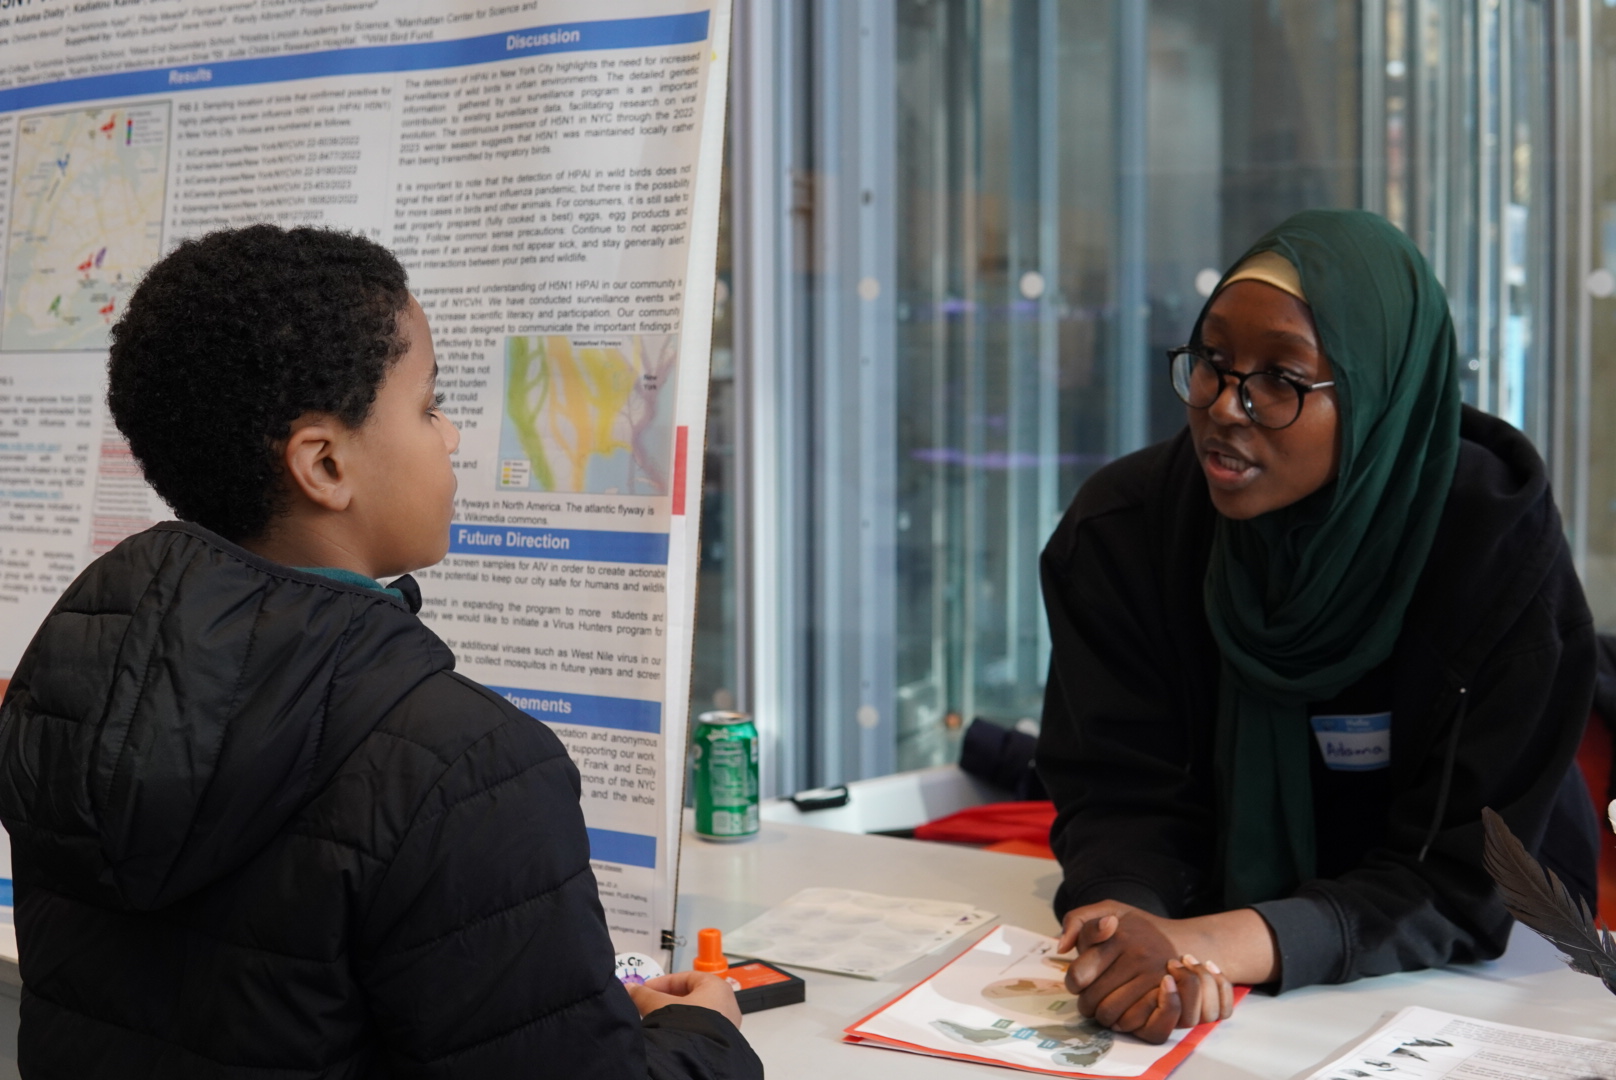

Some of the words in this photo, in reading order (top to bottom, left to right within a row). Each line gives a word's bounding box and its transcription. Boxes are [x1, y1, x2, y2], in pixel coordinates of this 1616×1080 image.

[506, 28, 580, 50] Discussion
[169, 68, 212, 84] Results
[422, 286, 463, 294] awareness
[465, 284, 480, 294] and
[482, 282, 536, 293] understanding
[538, 281, 546, 290] of
[548, 280, 572, 290] H5N1
[575, 279, 598, 289] HPAI
[612, 281, 626, 289] our
[630, 279, 675, 289] community
[440, 298, 448, 307] of
[452, 297, 483, 306] NYCVH.
[488, 297, 501, 305] We
[506, 297, 524, 305] have
[528, 295, 572, 304] conducted
[576, 294, 629, 303] surveillance
[634, 293, 664, 302] events
[470, 310, 502, 320] scientific
[506, 310, 534, 319] literacy
[537, 309, 553, 318] and
[556, 308, 611, 318] participation.
[617, 307, 633, 317] Our
[451, 325, 466, 334] also
[470, 324, 504, 335] designed
[507, 324, 514, 332] to
[518, 323, 572, 331] communicate
[576, 322, 589, 331] the
[593, 322, 635, 332] important
[639, 321, 671, 333] findings
[436, 338, 472, 349] effectively
[474, 338, 482, 347] to
[483, 338, 496, 346] the
[447, 351, 468, 360] While
[470, 351, 484, 360] this
[460, 365, 475, 374] has
[477, 365, 490, 374] not
[458, 378, 486, 387] burden
[456, 392, 478, 401] could
[460, 406, 483, 414] threat
[461, 498, 490, 509] flyways
[501, 500, 524, 509] North
[526, 501, 562, 511] America.
[566, 501, 582, 512] The
[584, 504, 615, 513] atlantic
[617, 504, 644, 516] flyway
[647, 506, 654, 515] is
[464, 512, 505, 522] Wikimedia
[507, 516, 548, 524] commons.
[458, 528, 502, 546] Future
[506, 532, 570, 550] Direction
[482, 561, 515, 569] samples
[518, 561, 529, 570] for
[532, 562, 547, 571] AIV
[561, 565, 583, 573] order
[586, 566, 595, 574] to
[598, 567, 625, 576] create
[430, 570, 442, 578] the
[444, 571, 478, 581] potential
[481, 573, 488, 582] to
[491, 573, 511, 584] keep
[514, 576, 527, 584] our
[531, 576, 545, 587] city
[548, 576, 566, 586] safe
[569, 577, 580, 587] for
[584, 579, 619, 590] humans
[622, 582, 639, 591] and
[462, 600, 504, 612] expanding
[508, 602, 521, 612] the
[525, 605, 560, 615] program
[565, 606, 574, 615] to
[578, 608, 601, 617] more
[610, 610, 648, 620] students
[456, 613, 480, 622] would
[483, 614, 497, 624] like
[500, 615, 508, 624] to
[512, 617, 539, 626] initiate
[552, 618, 574, 629] Virus
[578, 621, 612, 632] Hunters
[616, 625, 651, 636] program
[447, 639, 456, 649] for
[460, 640, 499, 651] additional
[502, 644, 530, 654] viruses
[534, 647, 554, 656] such
[557, 649, 567, 657] as
[571, 648, 593, 659] West
[596, 650, 613, 661] Nile
[617, 653, 638, 663] virus
[640, 655, 648, 663] in
[464, 654, 472, 663] to
[474, 655, 501, 665] collect
[503, 659, 546, 669] mosquitos
[560, 662, 585, 673] future
[589, 666, 612, 675] years
[616, 668, 633, 677] and
[591, 733, 607, 741] and
[610, 735, 657, 747] anonymous
[572, 745, 617, 758] supporting
[619, 750, 634, 758] our
[636, 752, 656, 761] work.
[583, 758, 608, 770] Frank
[613, 763, 631, 773] and
[635, 764, 656, 777] Emily
[608, 776, 617, 785] of
[620, 777, 634, 788] the
[637, 779, 655, 790] NYC
[591, 790, 608, 799] and
[612, 791, 627, 801] the
[631, 794, 655, 805] whole
